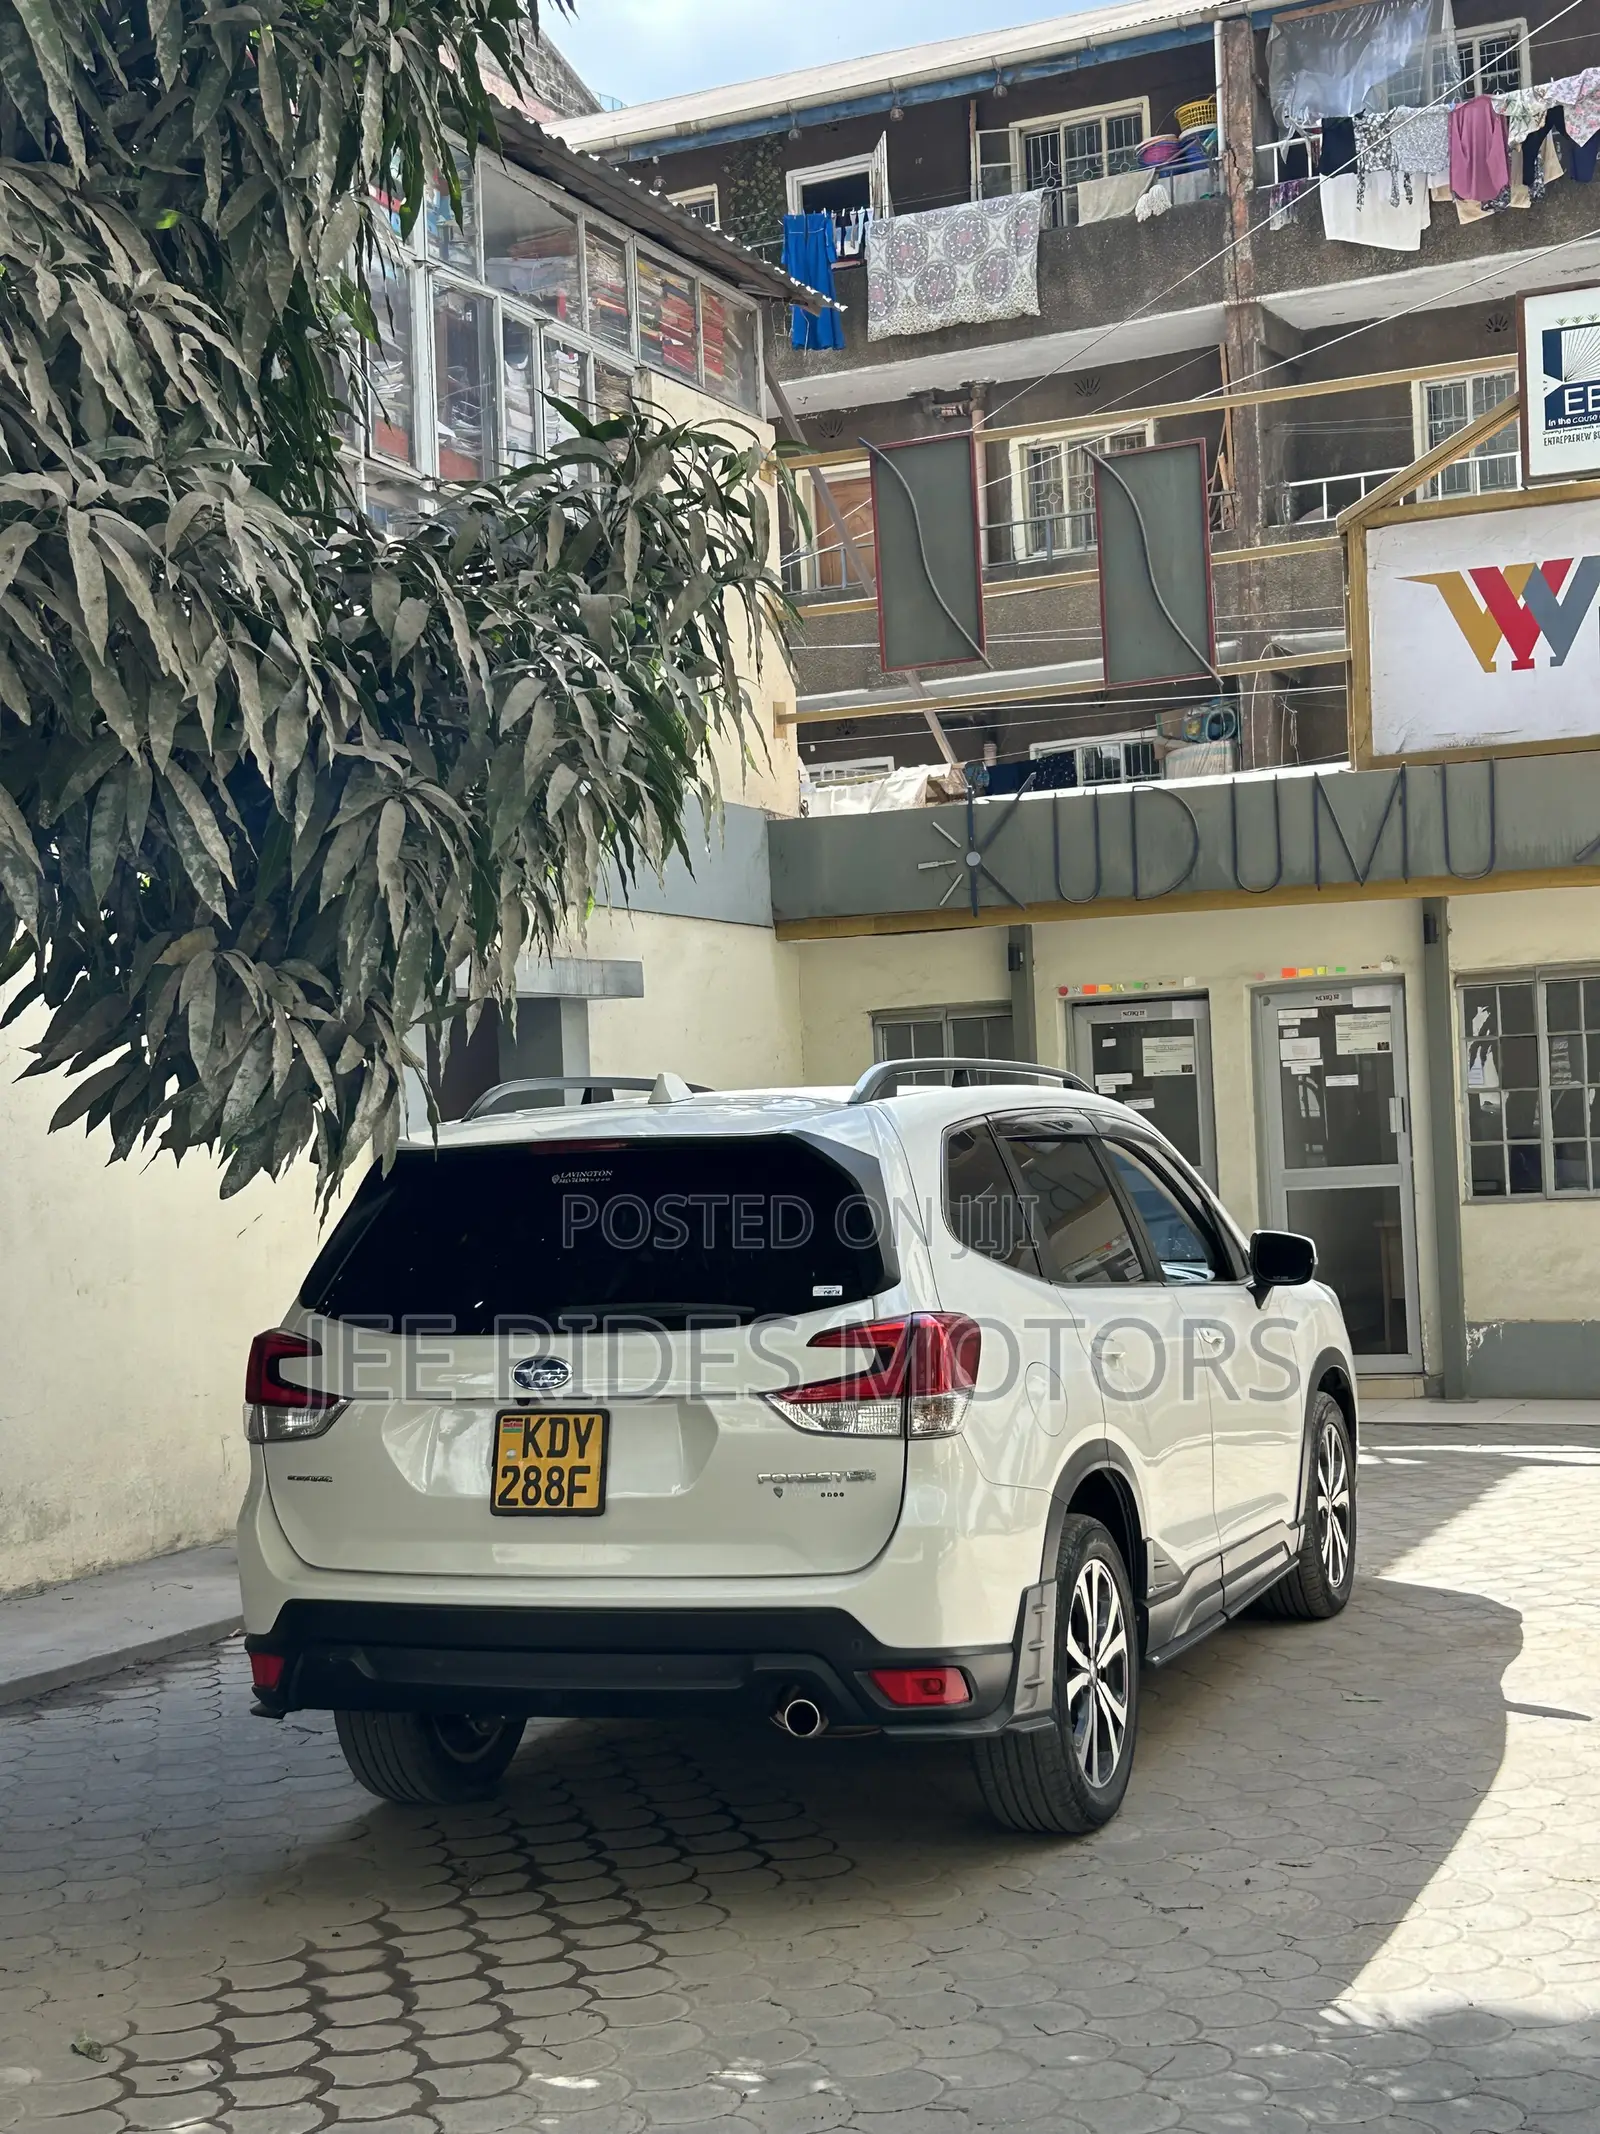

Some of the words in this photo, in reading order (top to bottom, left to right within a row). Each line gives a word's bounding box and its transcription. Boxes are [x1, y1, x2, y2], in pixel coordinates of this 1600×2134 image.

[1548, 419, 1557, 427] In
[1558, 417, 1571, 425] the
[561, 1170, 613, 1179] LAVINGTON
[522, 1417, 595, 1459] KDY
[498, 1465, 591, 1507] 288F
